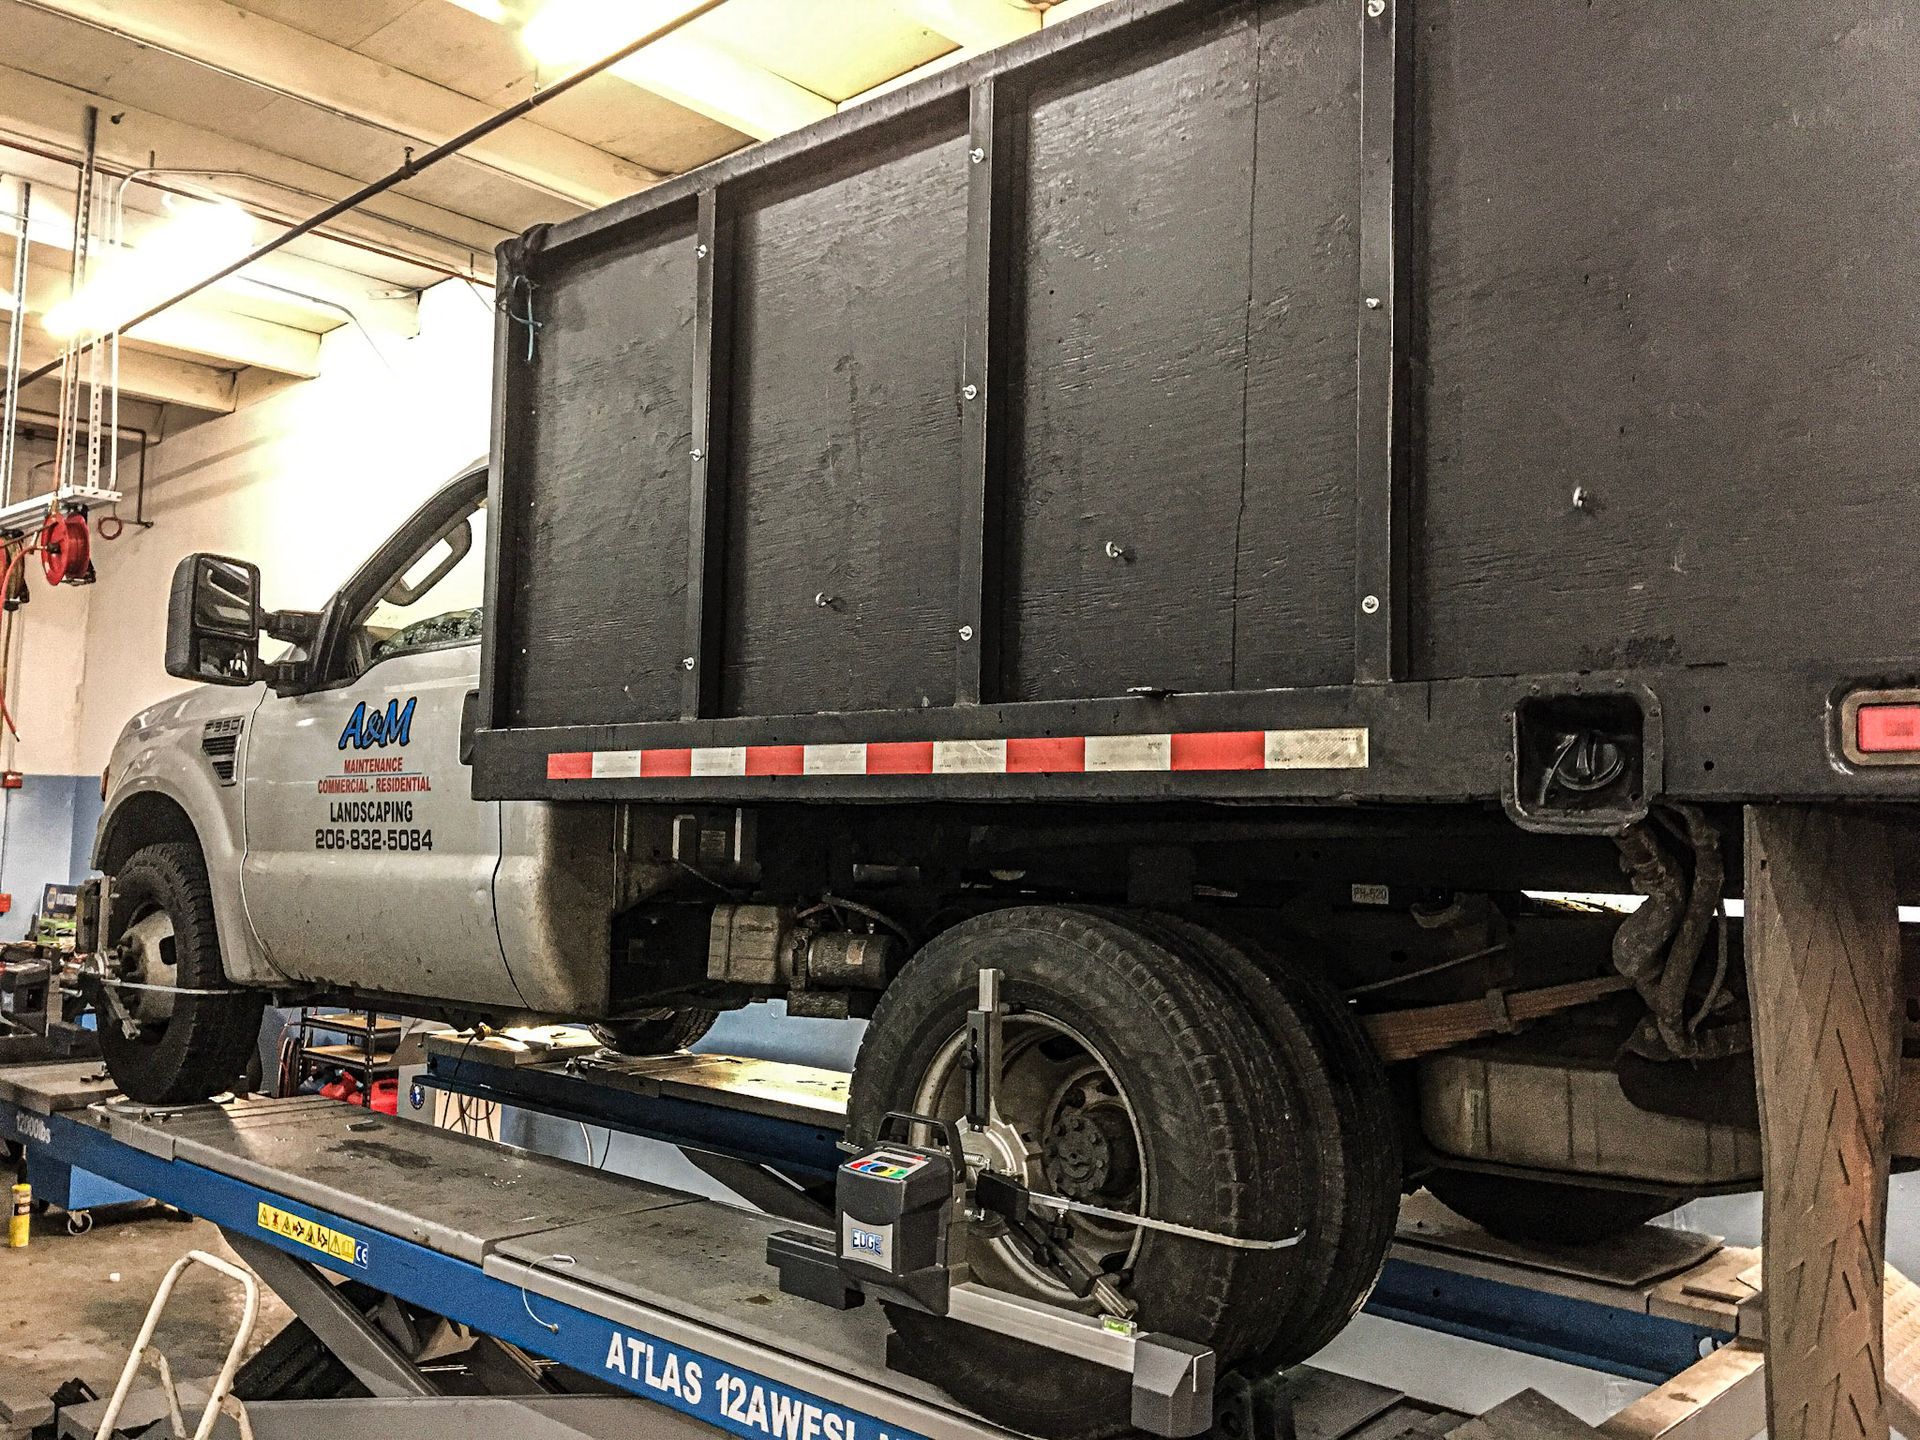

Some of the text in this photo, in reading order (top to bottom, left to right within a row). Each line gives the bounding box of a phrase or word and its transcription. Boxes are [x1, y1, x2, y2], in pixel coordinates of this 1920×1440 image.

[338, 696, 417, 750] A&M
[344, 757, 403, 773] MAINTENANCE
[318, 778, 369, 794] COMMERCIAL
[376, 776, 431, 793] RESIDENTIAL
[330, 801, 413, 822] LANDSCAPING
[851, 1228, 883, 1256] EDGE
[605, 1331, 703, 1405] ATLAS
